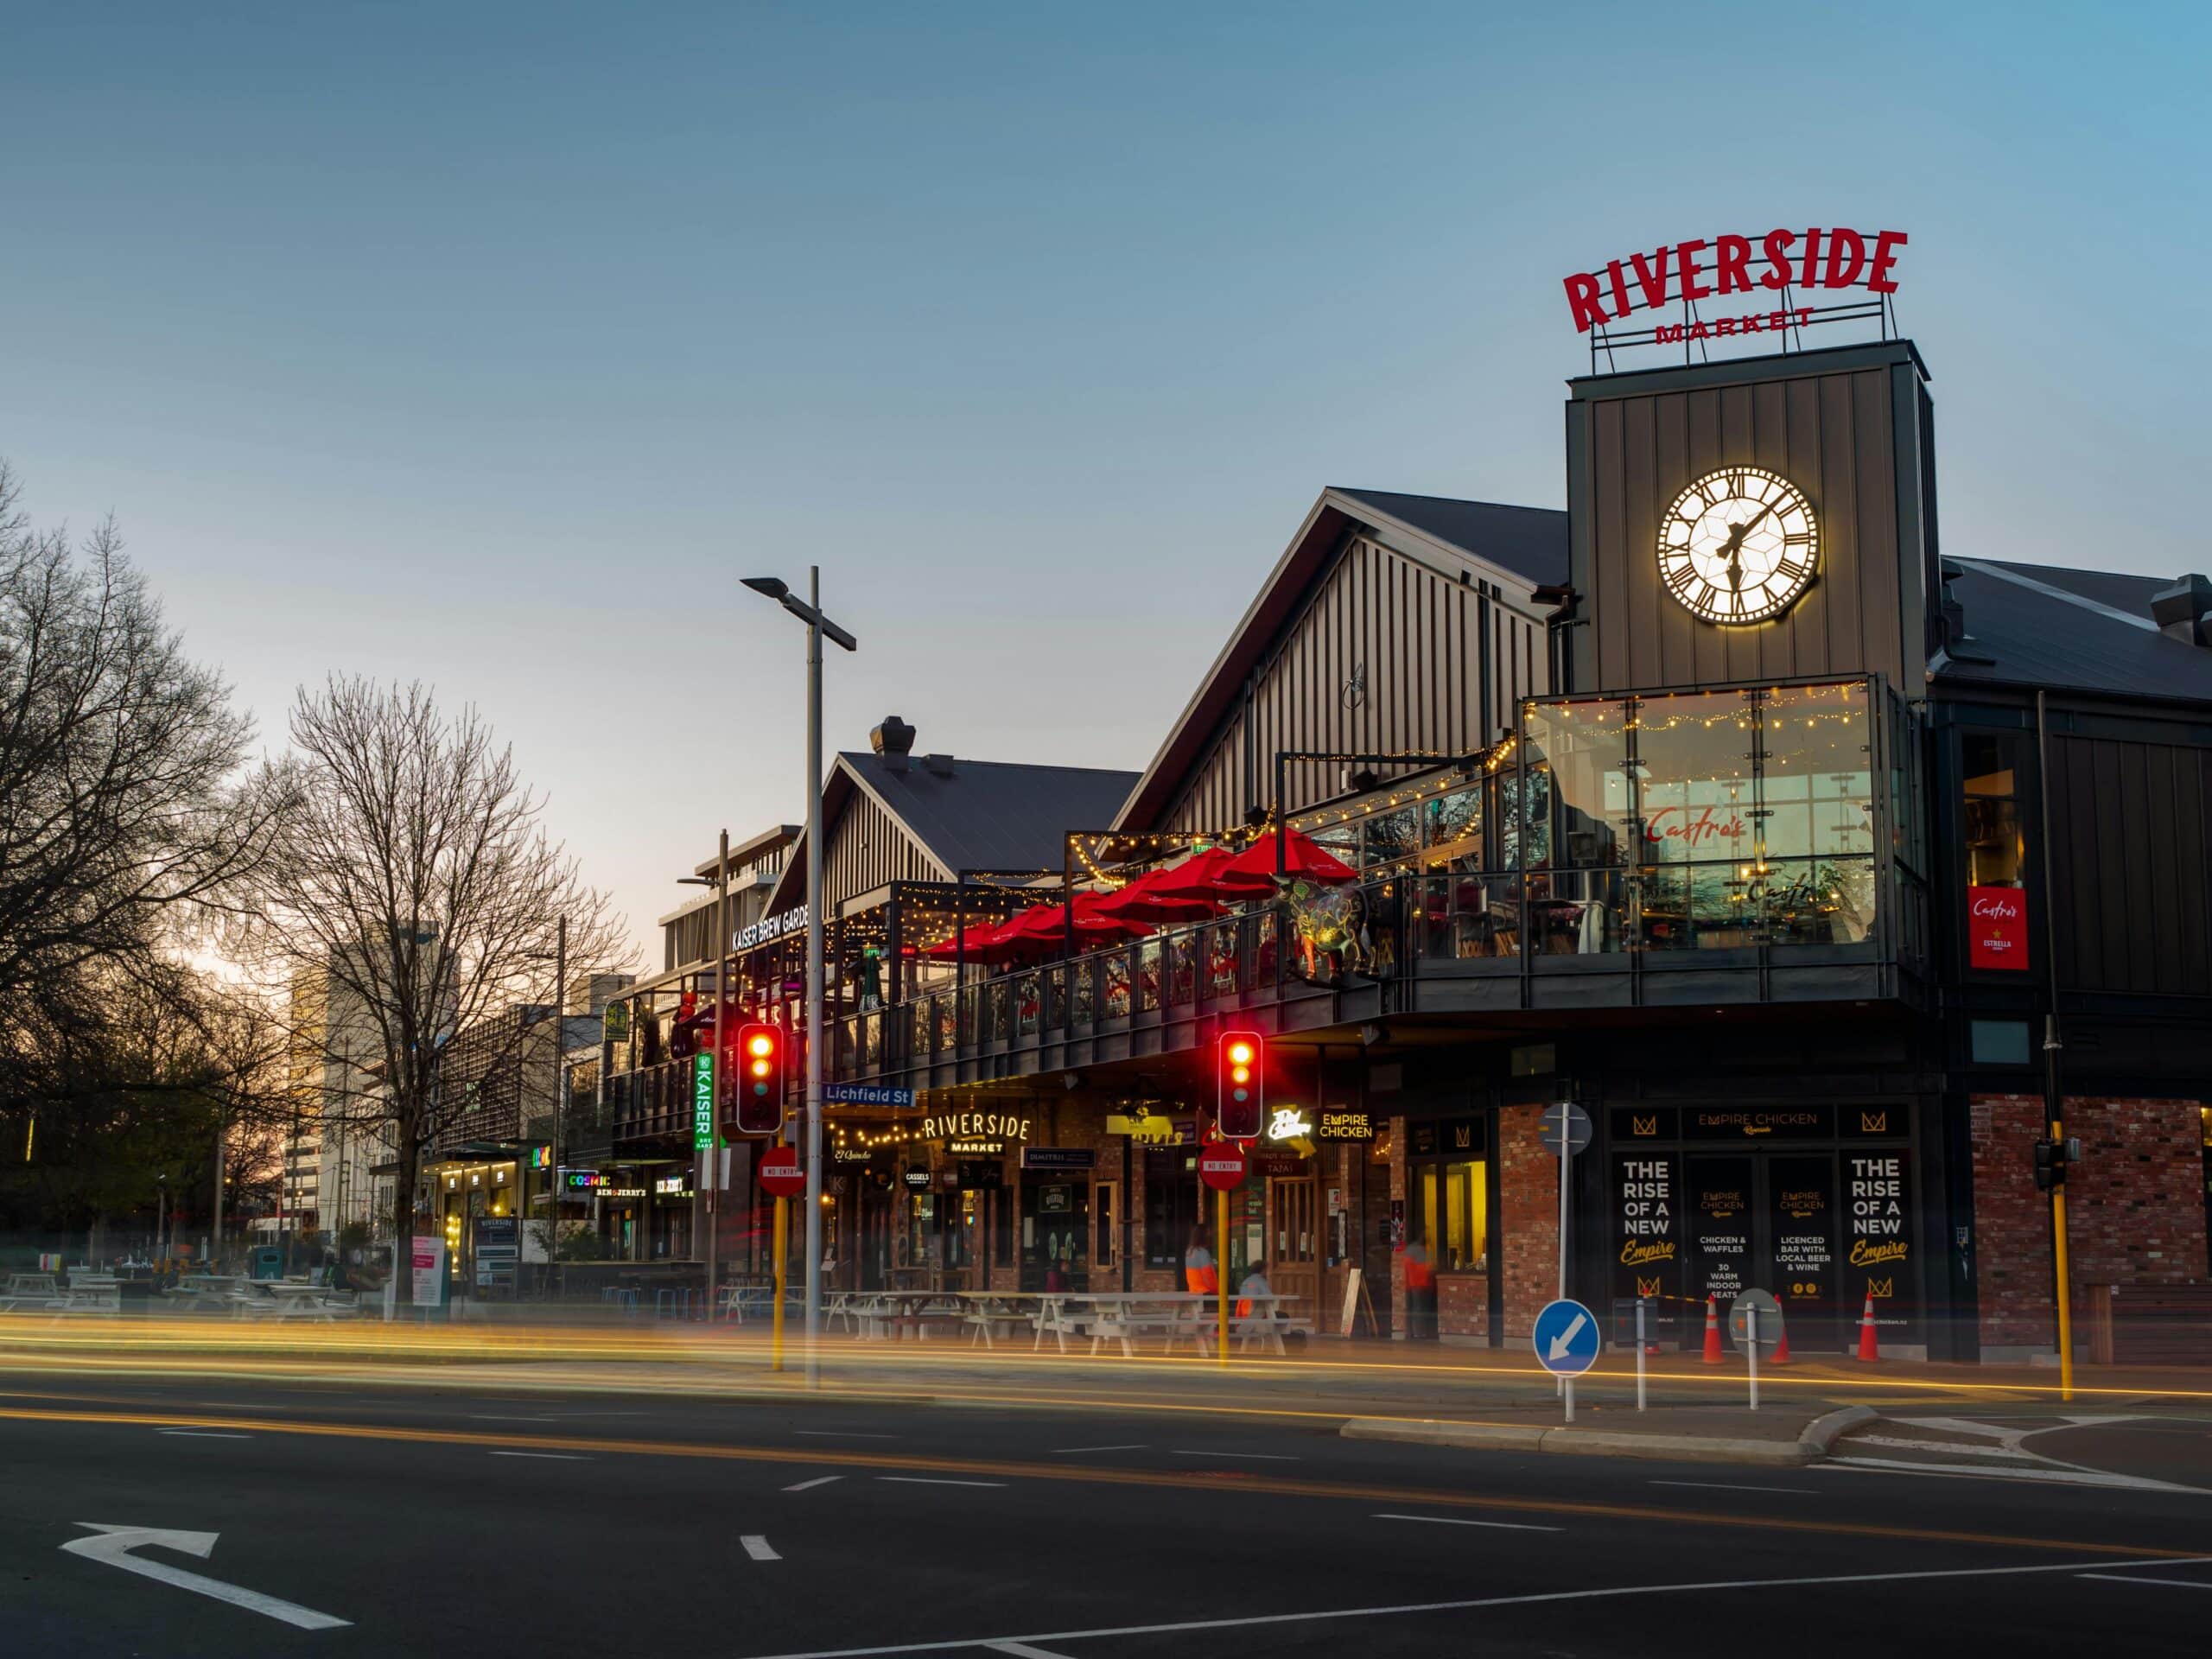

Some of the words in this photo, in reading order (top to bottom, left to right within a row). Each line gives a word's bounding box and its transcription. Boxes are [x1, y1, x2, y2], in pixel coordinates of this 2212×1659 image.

[1563, 228, 1908, 334] RIVERSIDE
[1656, 307, 1815, 345] MARKET
[1646, 806, 1746, 847] Castro's
[1974, 898, 2018, 919] Castro's
[732, 924, 758, 951] KAISER
[760, 913, 781, 942] BREW
[782, 904, 809, 932] GARDE
[696, 1071, 711, 1134] KAISER
[827, 1087, 890, 1103] Lichfield
[893, 1090, 908, 1103] St
[925, 1113, 1031, 1141] RIVERSIDE
[1323, 1114, 1369, 1126] EMPIRE
[1699, 1114, 1751, 1125] EMPIRE
[1756, 1113, 1817, 1125] CHICKEN
[1320, 1127, 1373, 1138] CHICKEN
[950, 1142, 1003, 1153] MARKET
[1623, 1161, 1669, 1179] THE
[1852, 1159, 1900, 1177] THE
[569, 1175, 611, 1186] COSMIC
[1852, 1180, 1901, 1197] RISE
[1624, 1182, 1669, 1198] RISE
[1702, 1192, 1742, 1201] EMPIRE
[1783, 1192, 1821, 1201] EMPIRE
[1624, 1203, 1650, 1216] OF
[1656, 1203, 1669, 1216] A
[1700, 1201, 1745, 1210] CHICKEN
[1780, 1201, 1825, 1210] CHICKEN
[1853, 1201, 1881, 1216] OF
[1886, 1201, 1901, 1215] A
[1624, 1220, 1669, 1235] NEW
[1853, 1219, 1901, 1234] NEW
[1620, 1238, 1676, 1265] Empire
[1849, 1238, 1909, 1266] Empire
